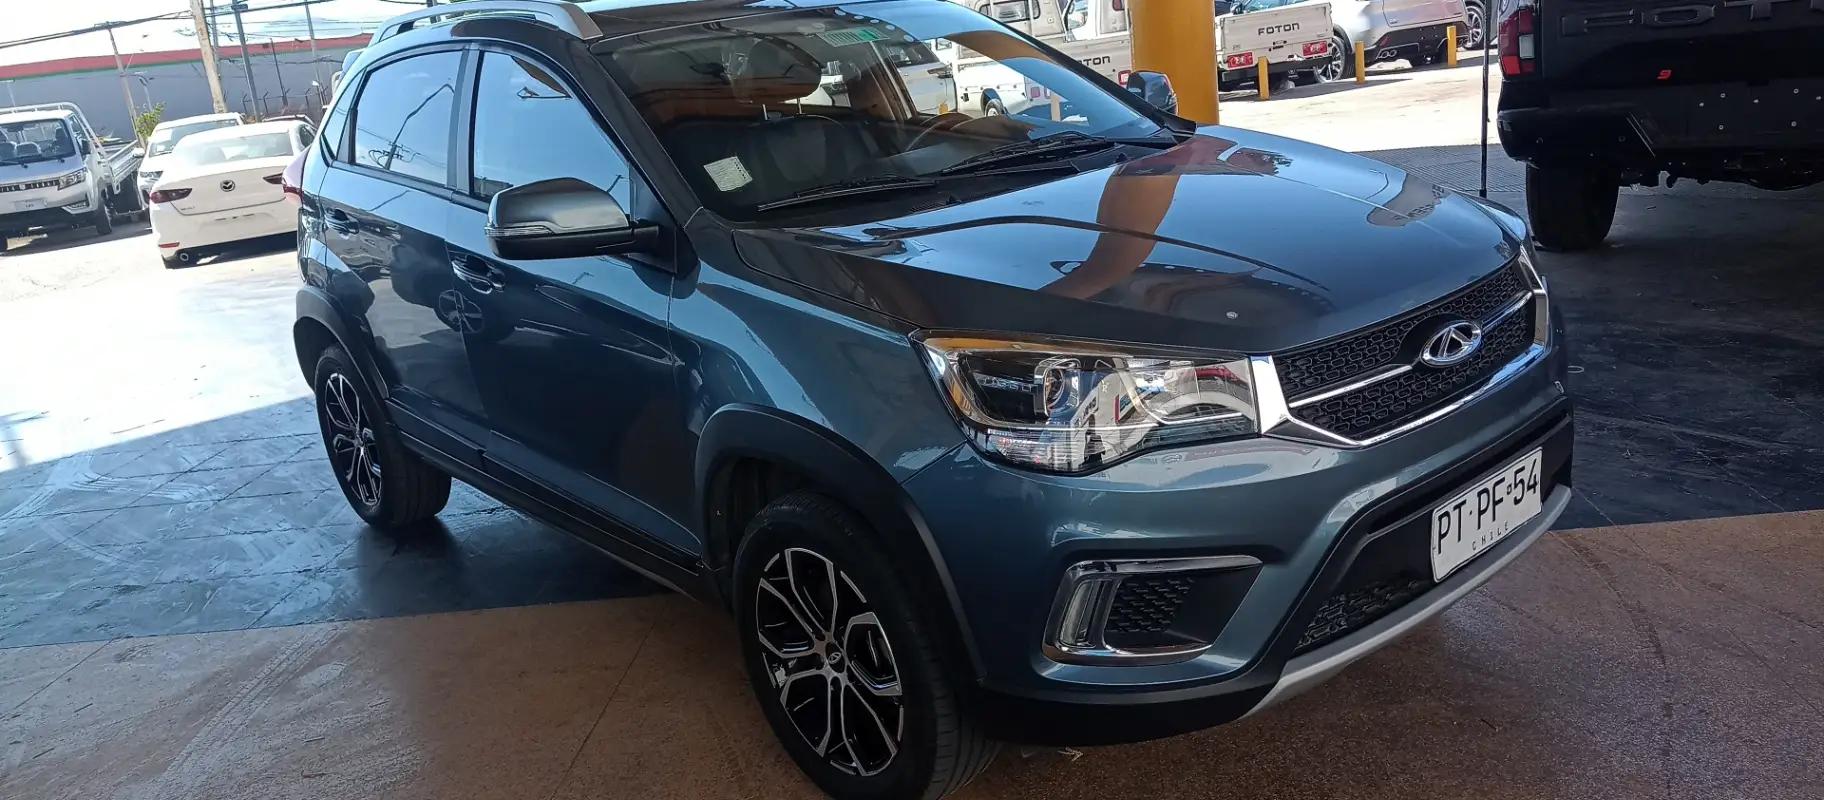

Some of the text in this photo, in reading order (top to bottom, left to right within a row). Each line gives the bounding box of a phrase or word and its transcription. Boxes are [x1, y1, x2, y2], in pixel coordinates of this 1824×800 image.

[1257, 22, 1300, 36] FOTON
[1560, 0, 1824, 36] FOT
[1078, 55, 1111, 66] TON
[1471, 521, 1509, 551] CHILE
